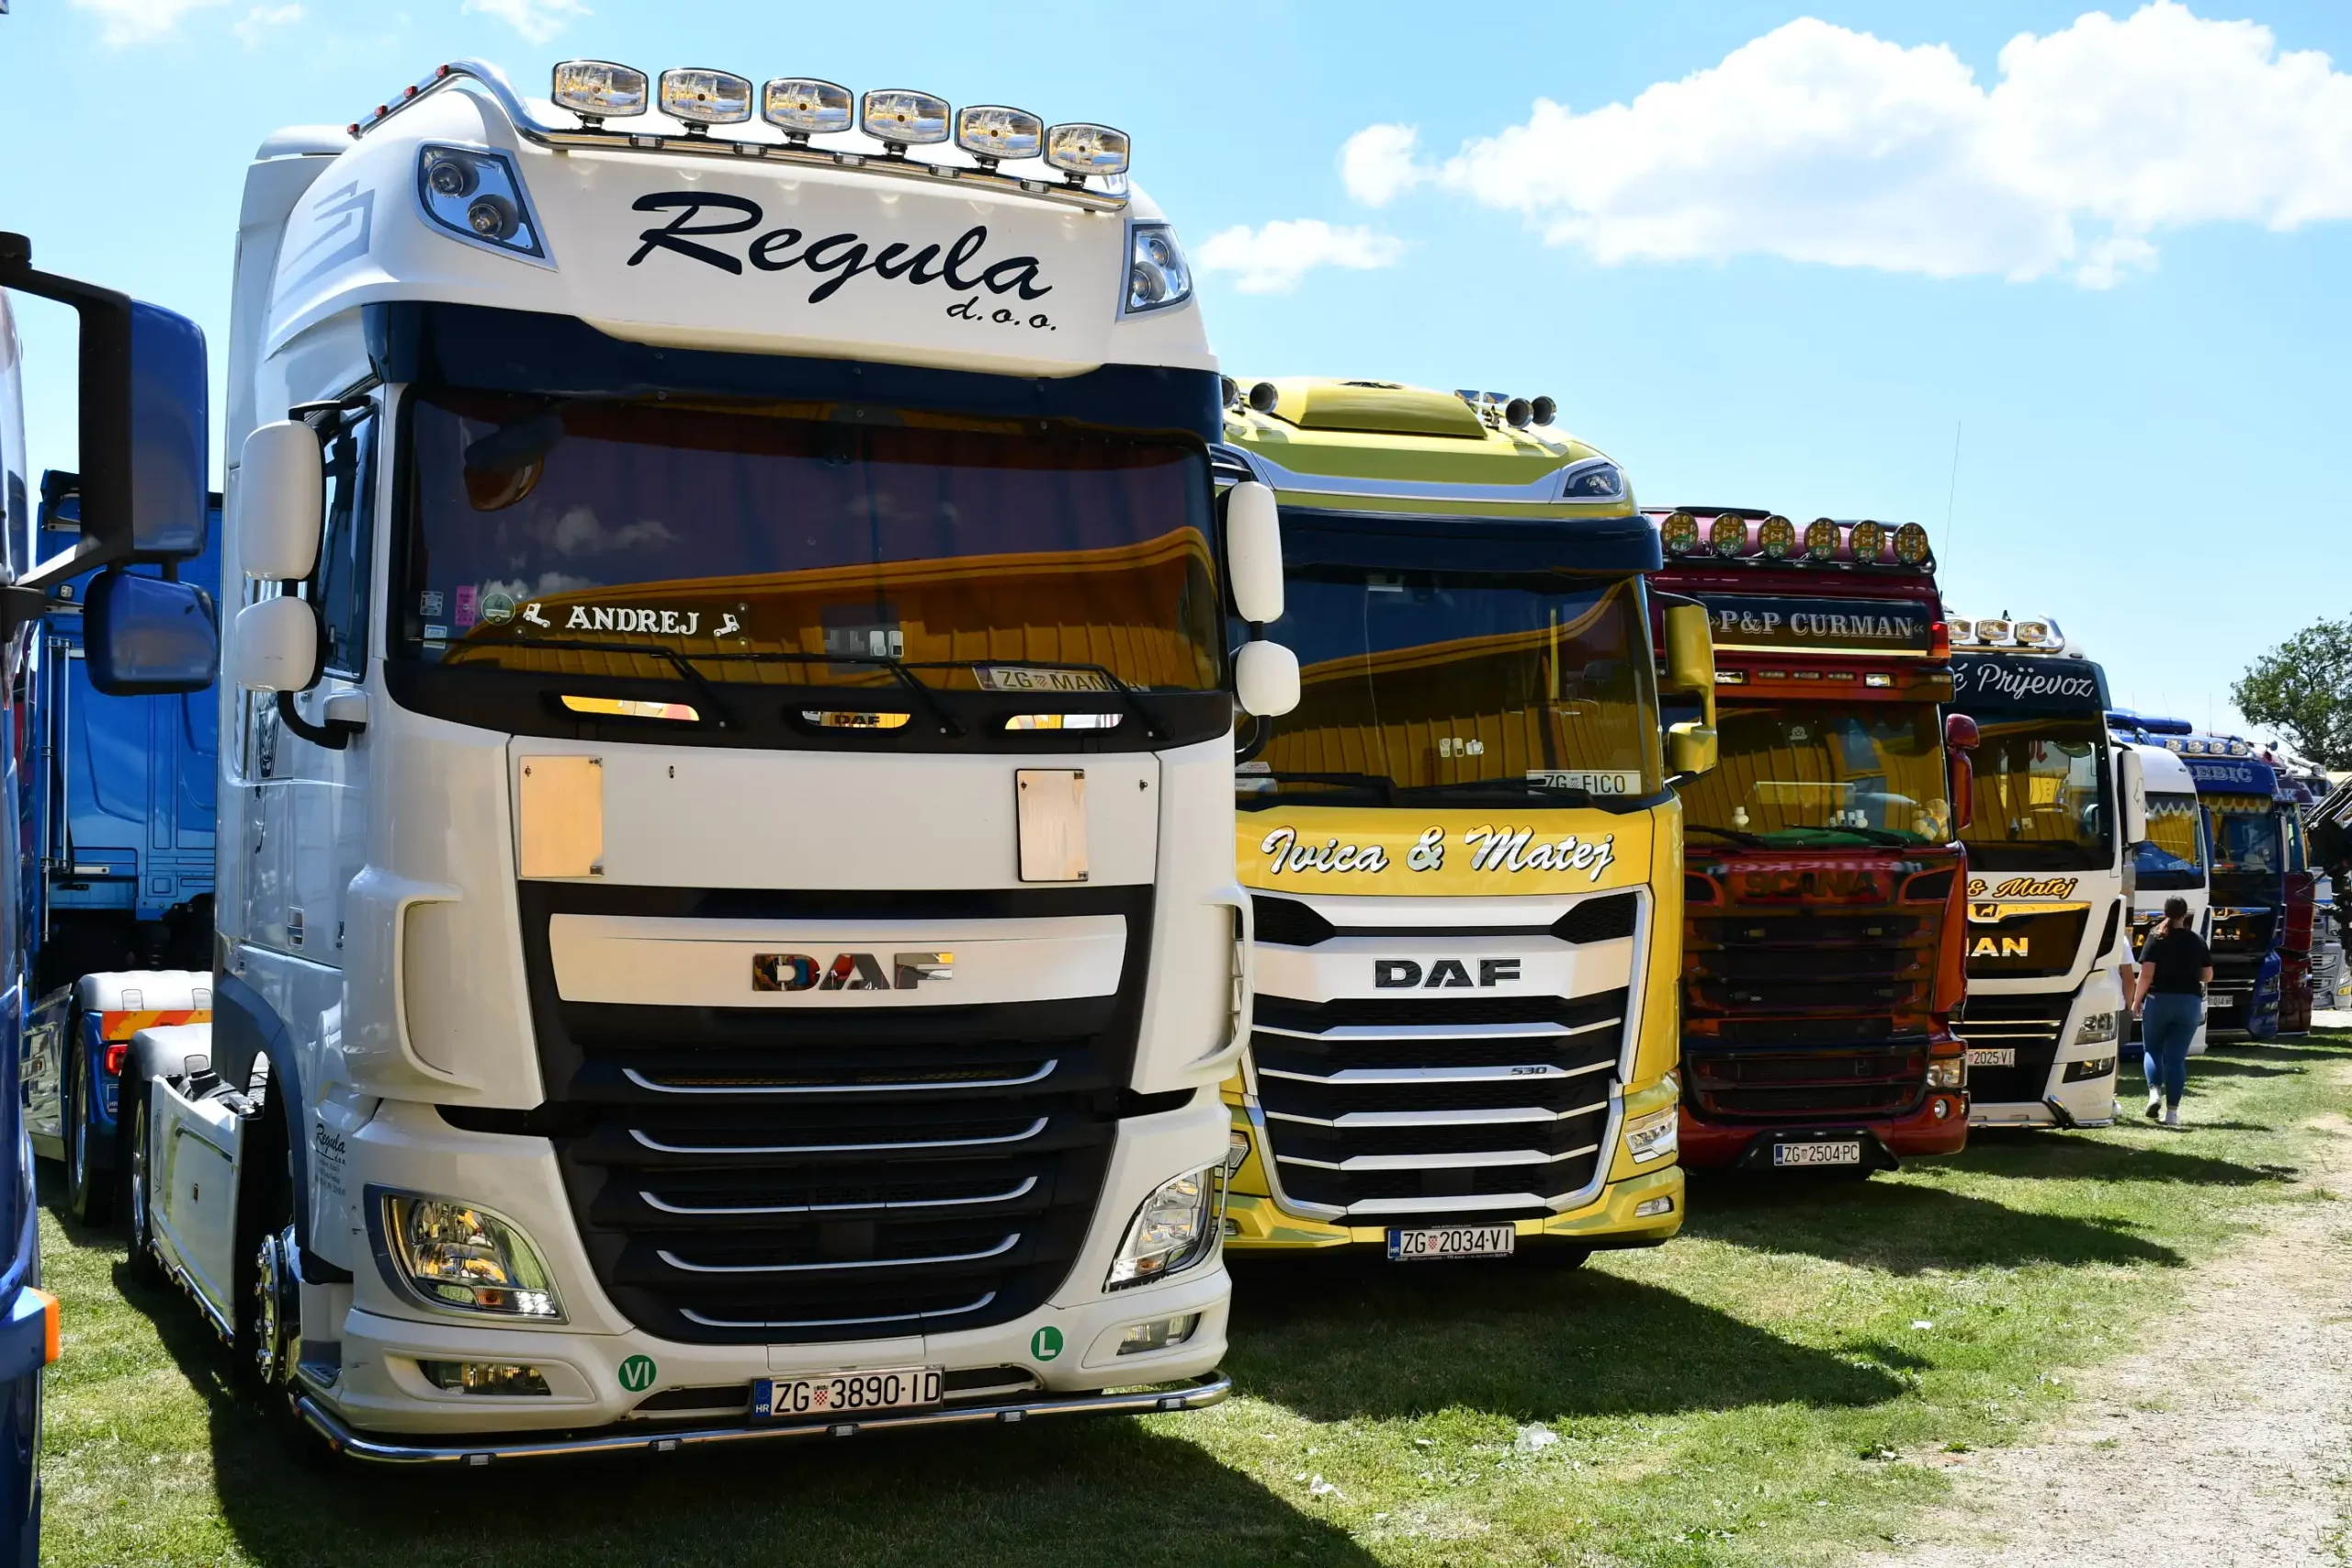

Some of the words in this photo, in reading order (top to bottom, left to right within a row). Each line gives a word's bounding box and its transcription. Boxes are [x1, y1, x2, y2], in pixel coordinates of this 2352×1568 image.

[627, 191, 1053, 304] Regula
[946, 296, 1057, 331] d.o.o.
[565, 605, 700, 635] ANDREJ
[997, 671, 1034, 688] ZG
[1977, 663, 2094, 700] Prijevoz
[1261, 825, 1390, 874] Ivica
[1407, 825, 1446, 872] &
[1464, 824, 1616, 883] Matej
[1992, 877, 2078, 899] Matej
[1966, 937, 2028, 956] AN
[752, 952, 956, 992] DAF
[1373, 957, 1523, 989] DAF
[1511, 1066, 1547, 1076] 530
[316, 1122, 346, 1155] Regula
[1784, 1147, 1800, 1162] ZG
[1403, 1232, 1426, 1253] ZG
[1038, 1331, 1056, 1356] L
[755, 1403, 770, 1413] HR
[773, 1381, 810, 1413] ZG
